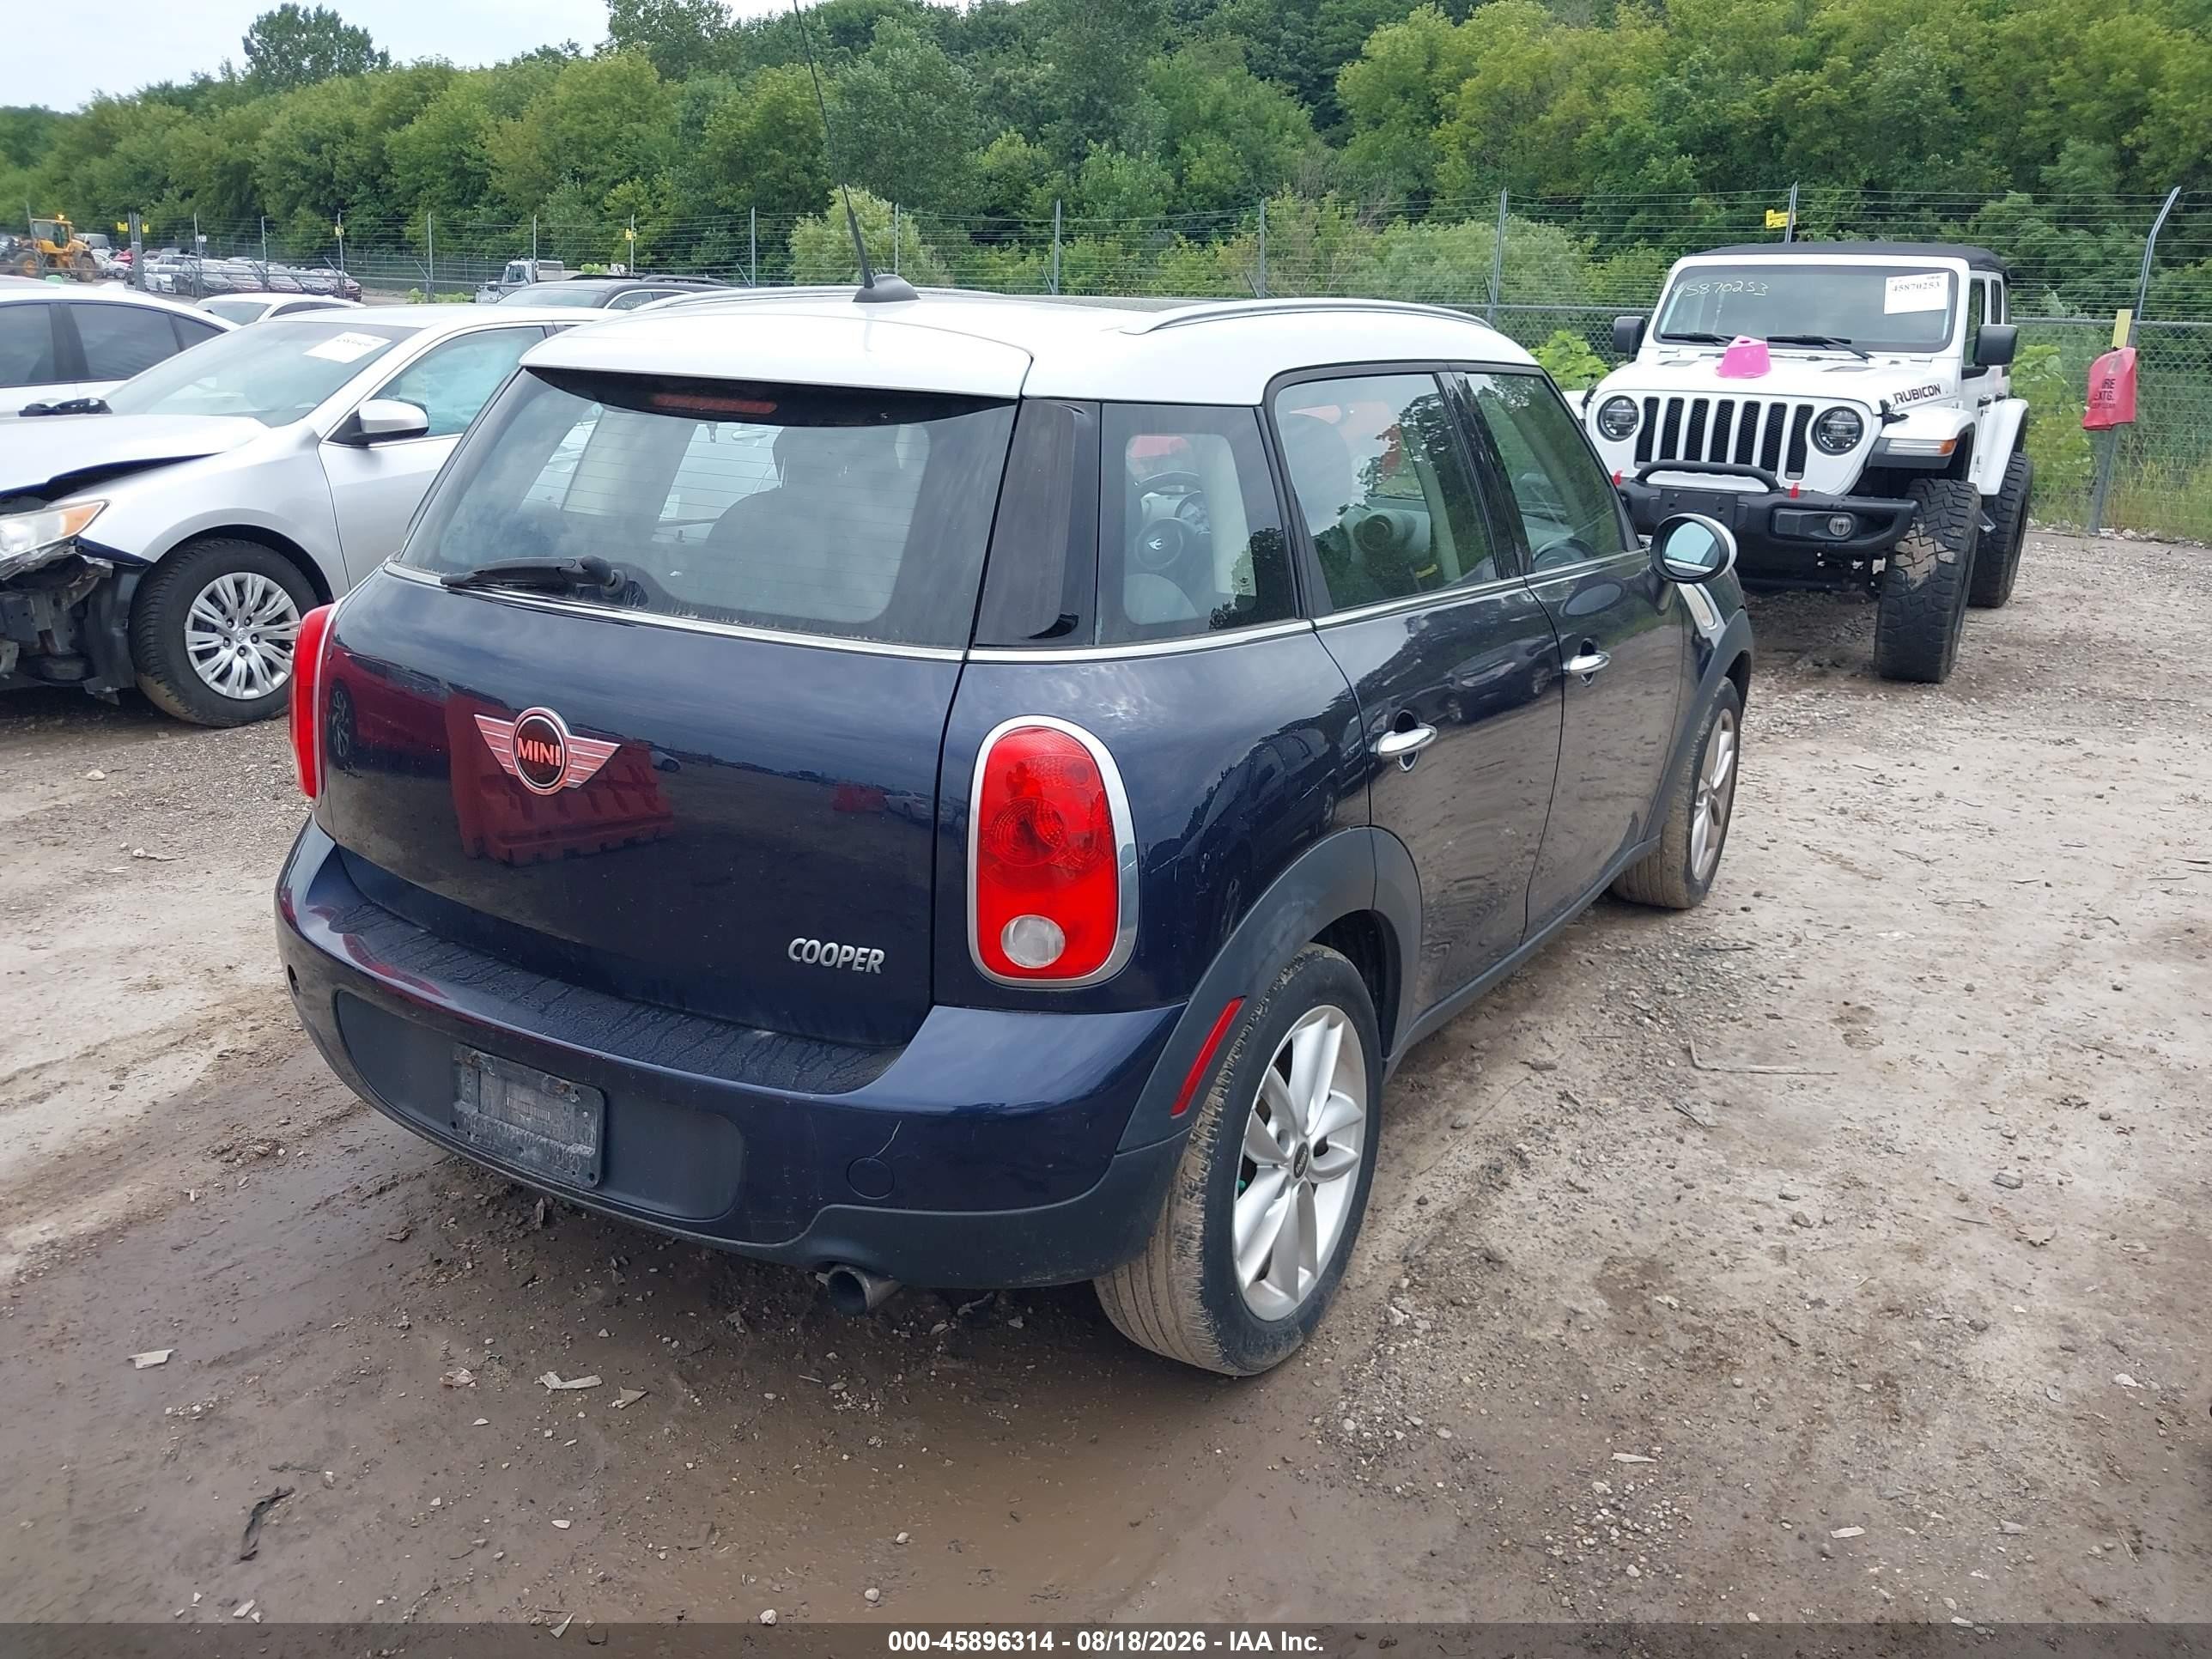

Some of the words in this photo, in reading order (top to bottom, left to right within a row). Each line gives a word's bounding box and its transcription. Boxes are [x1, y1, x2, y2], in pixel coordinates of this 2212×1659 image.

[1673, 280, 1769, 296] 45870253
[1892, 281, 1940, 293] 45870253
[1893, 383, 1942, 404] RUBICON
[517, 737, 561, 767] MINI
[787, 938, 885, 974] COOPER
